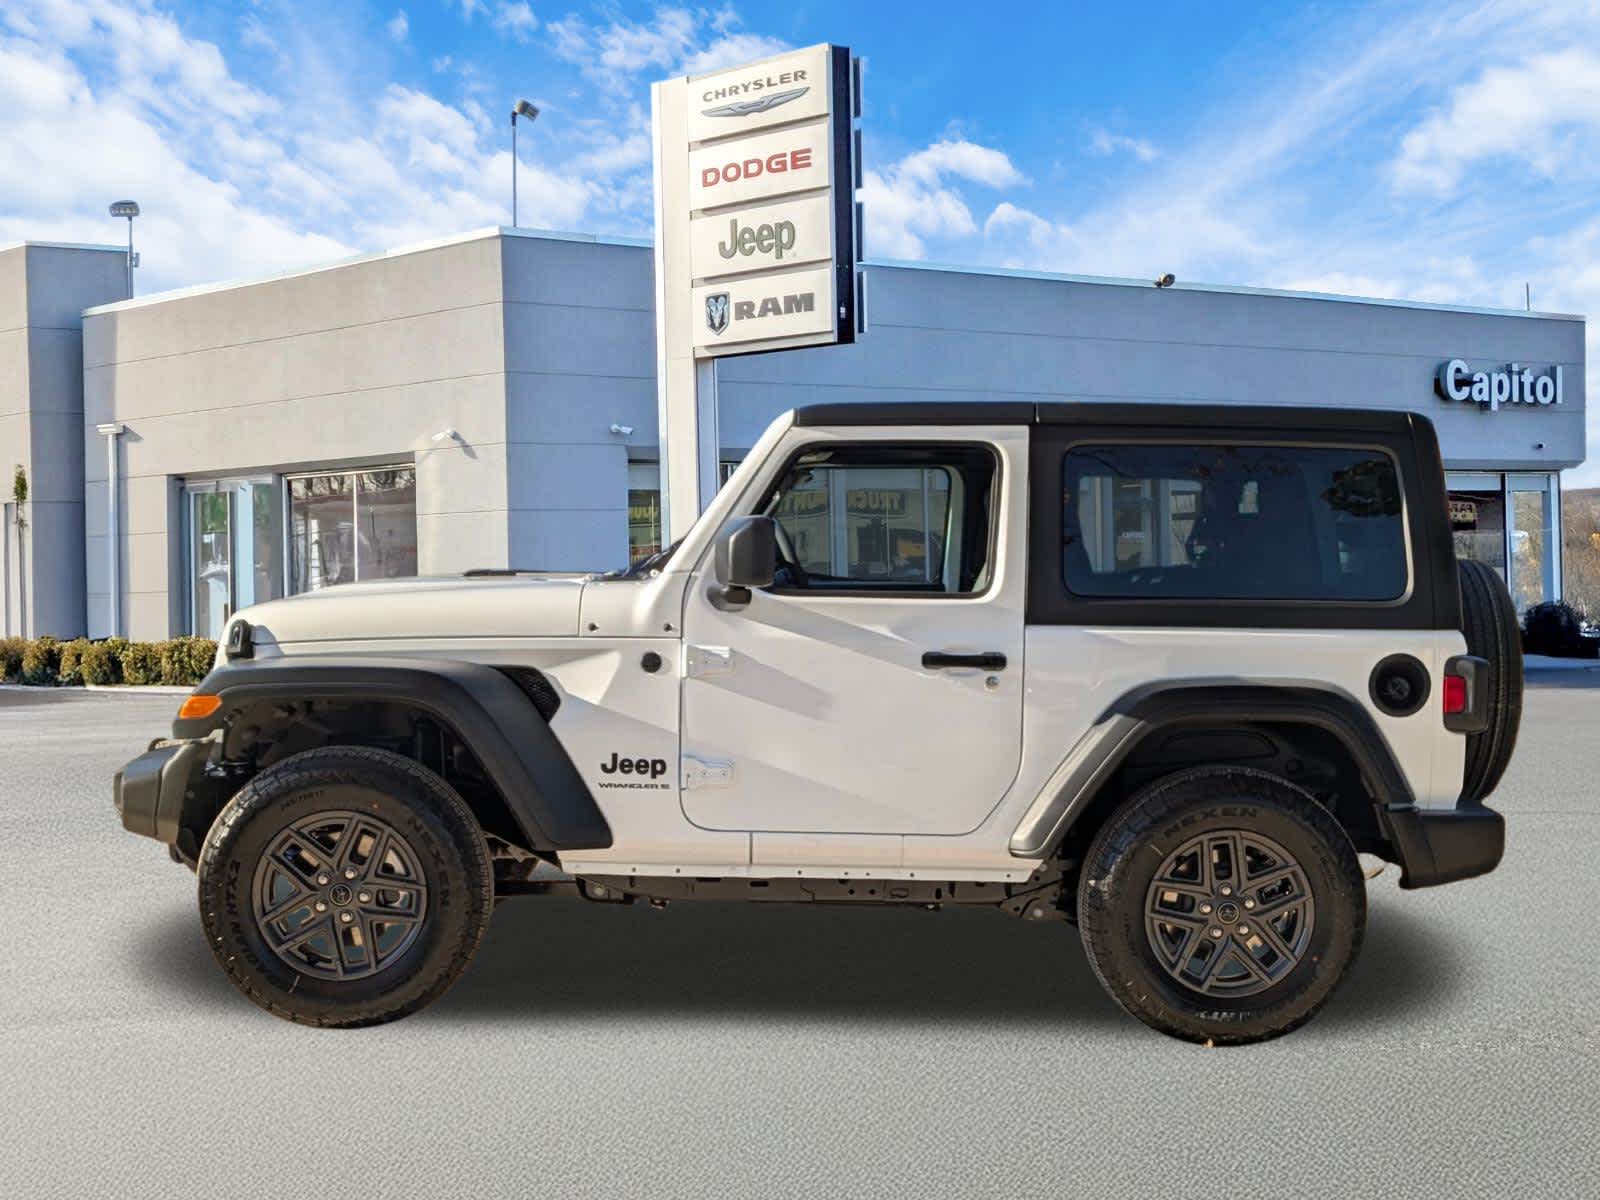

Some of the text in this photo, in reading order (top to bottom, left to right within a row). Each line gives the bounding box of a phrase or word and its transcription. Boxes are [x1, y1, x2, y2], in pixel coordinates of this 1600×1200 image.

[702, 70, 807, 103] CHRYSLER
[702, 148, 812, 188] DODGE
[718, 218, 796, 260] Jeep
[734, 293, 815, 321] RAM
[1446, 358, 1563, 411] Capitol
[600, 752, 667, 779] Jeep
